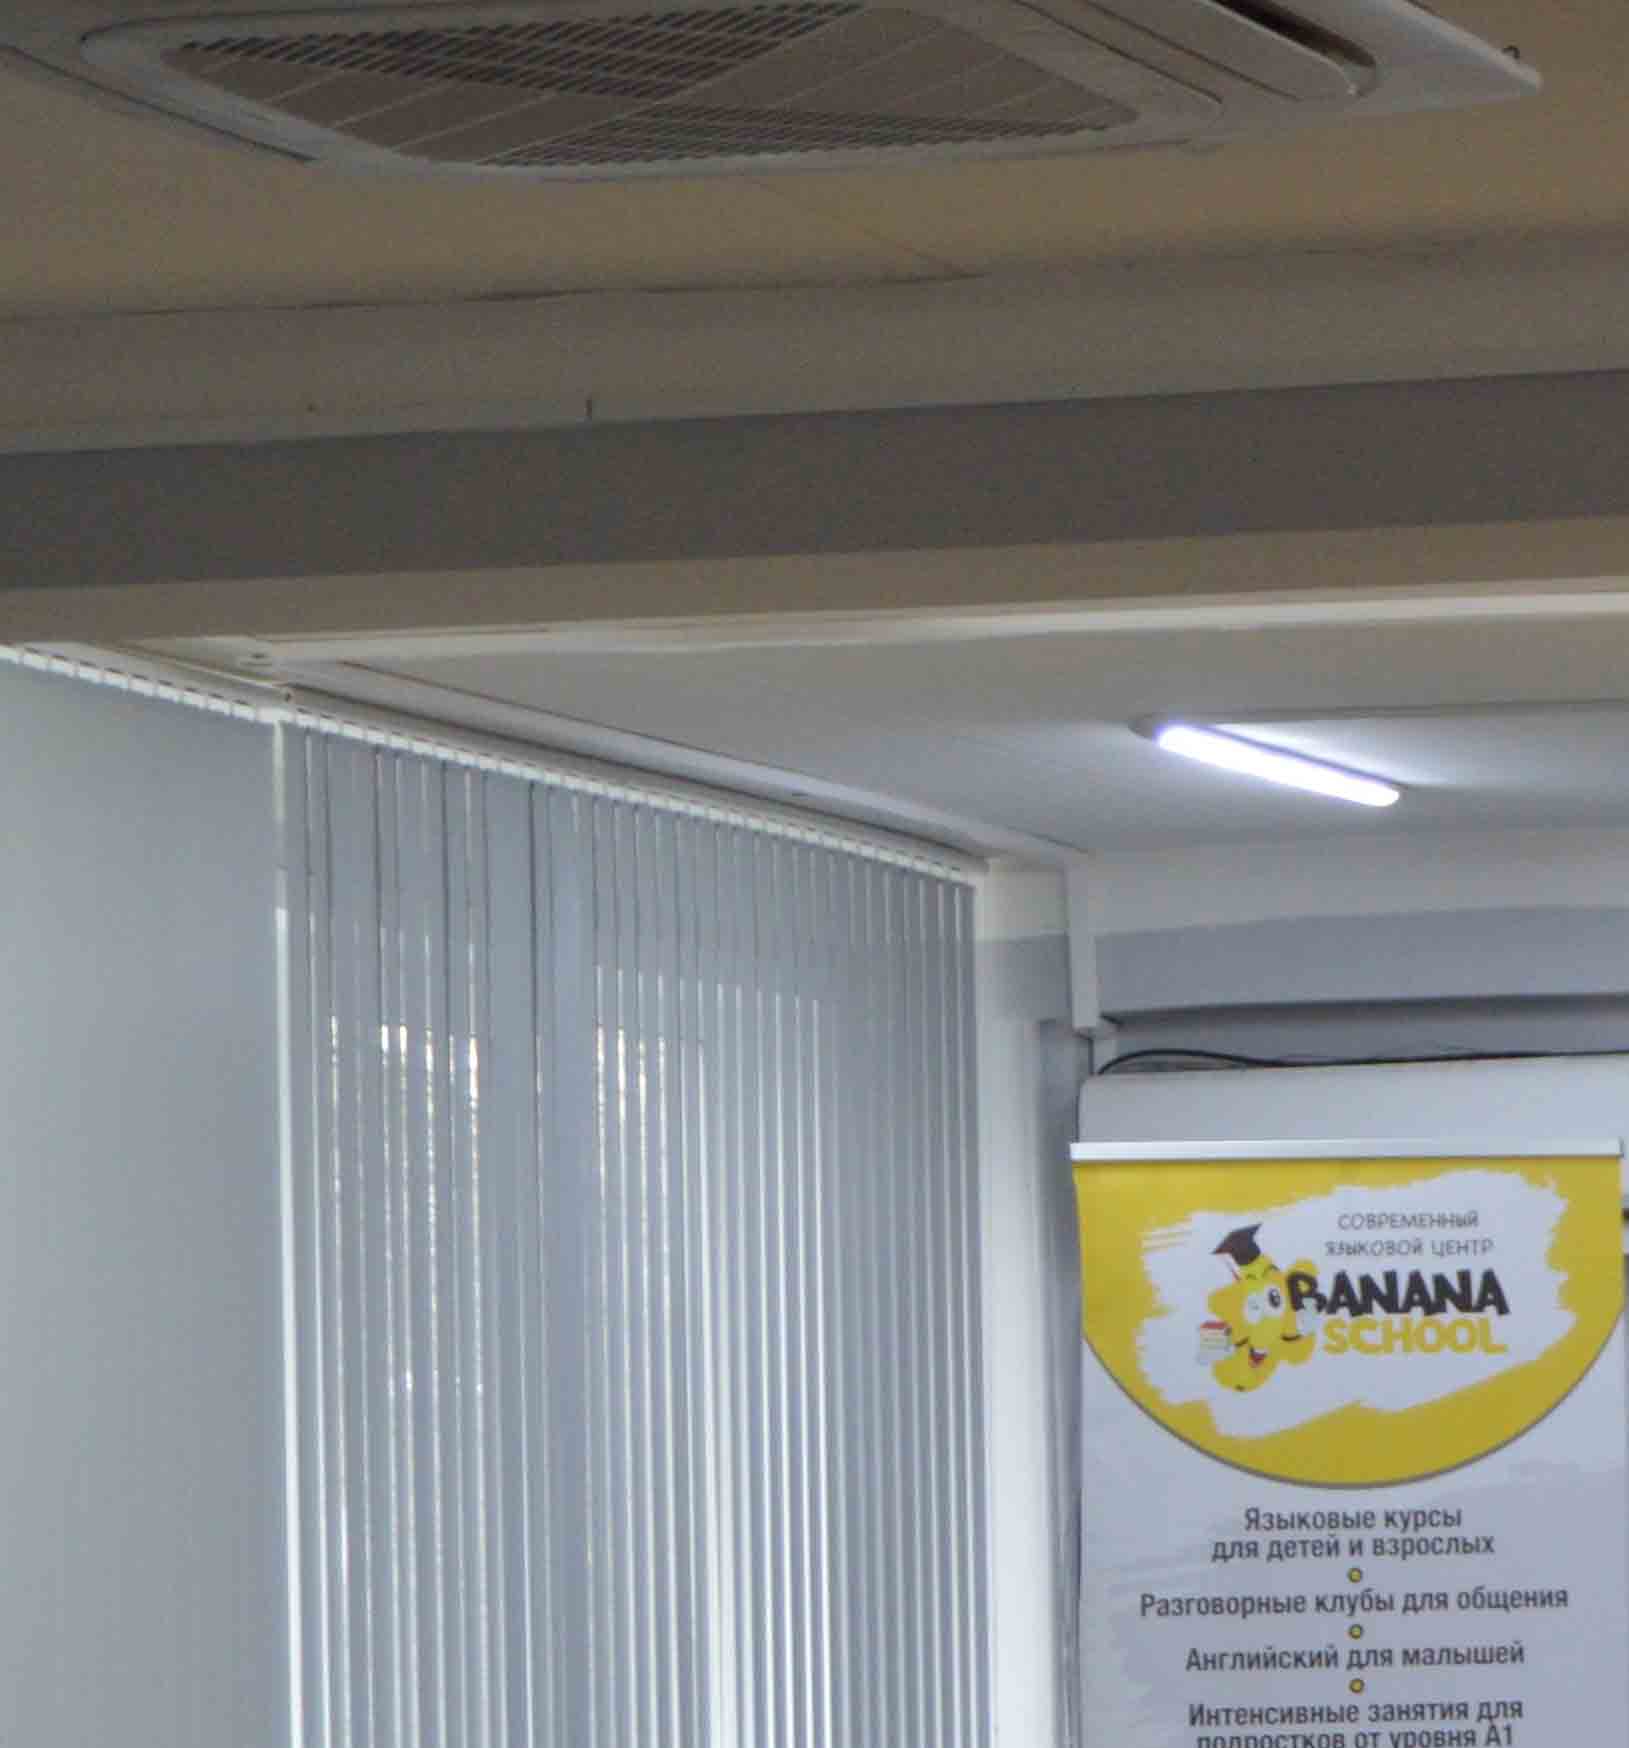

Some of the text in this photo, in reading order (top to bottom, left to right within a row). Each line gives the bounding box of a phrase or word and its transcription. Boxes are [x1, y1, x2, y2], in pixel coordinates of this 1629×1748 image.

[1337, 1209, 1480, 1231] СОВРЕМЕННЫЙ
[1325, 1236, 1494, 1258] ЯЗЫКОВОЙ ЦЕНТР
[1286, 1268, 1511, 1317] BANANA
[1322, 1317, 1509, 1355] SCHOOL
[1244, 1508, 1462, 1536] Языковые курсы
[1211, 1533, 1495, 1563] для детей и взрослых
[1140, 1585, 1569, 1621] Разговорные клубы для общения
[1185, 1642, 1525, 1673] Английский для малышей
[1189, 1700, 1523, 1728] Интенсивные занятия для
[1484, 1725, 1514, 1748] А1
